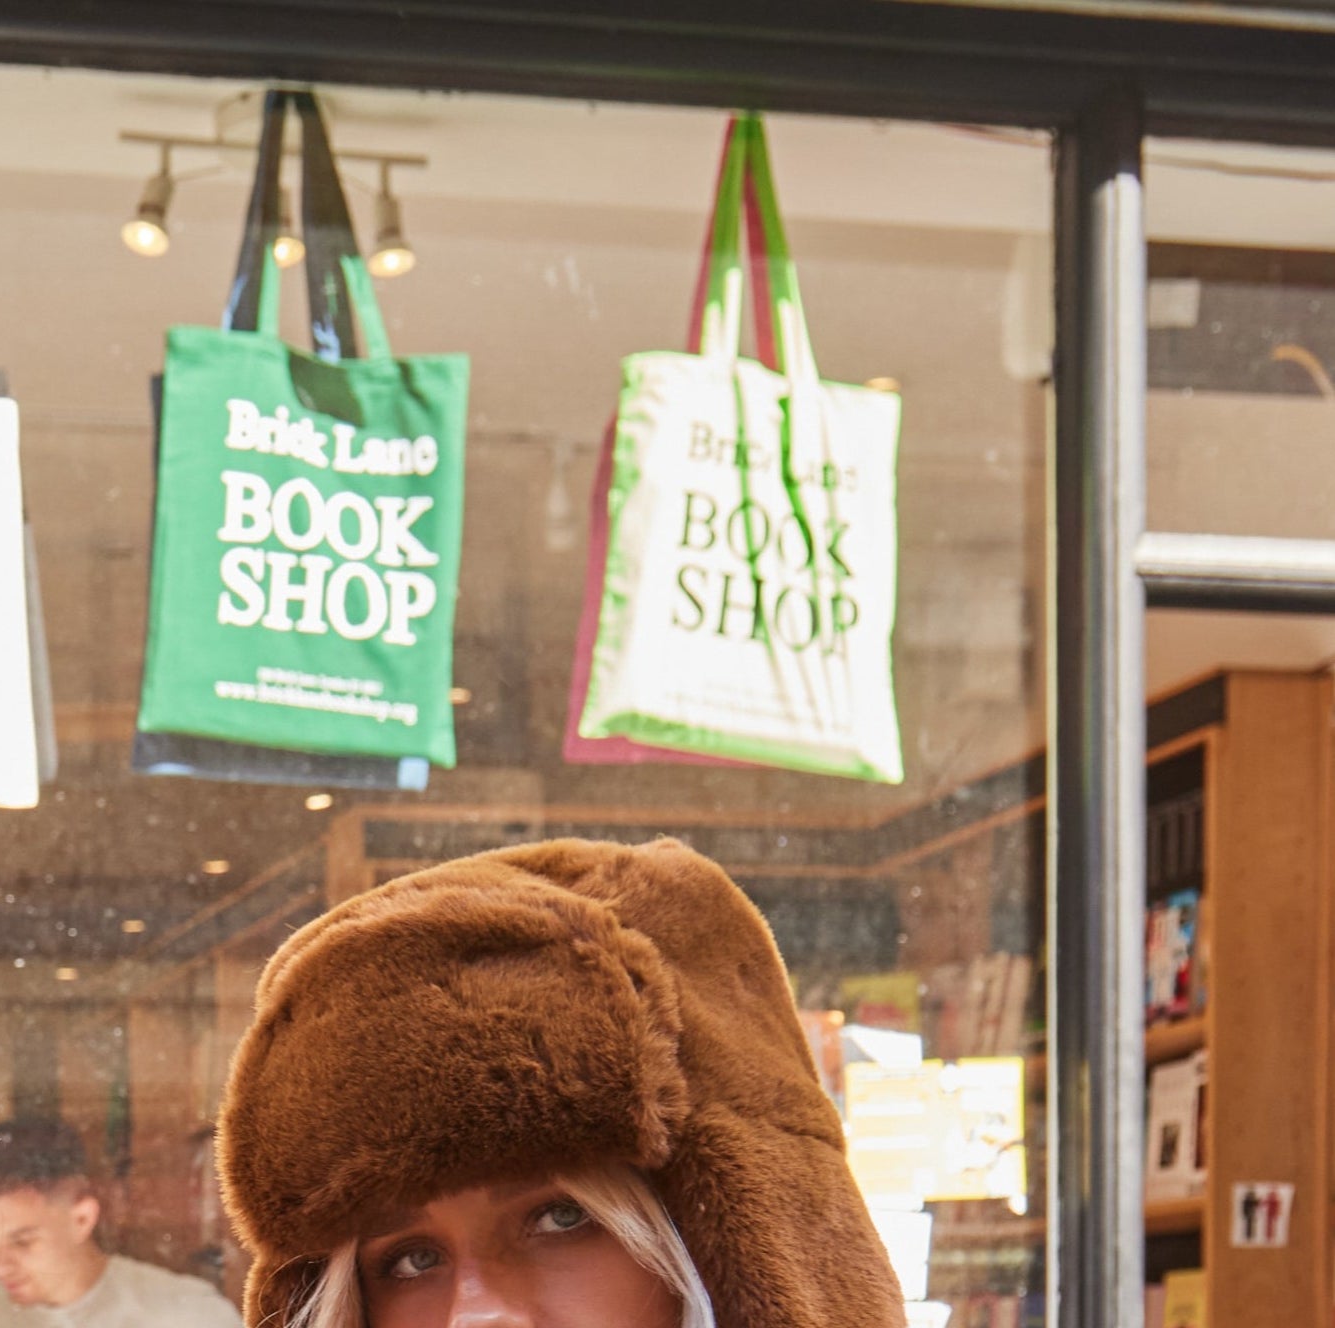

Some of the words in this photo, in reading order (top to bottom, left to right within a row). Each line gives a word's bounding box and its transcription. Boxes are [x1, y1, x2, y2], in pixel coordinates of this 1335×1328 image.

[225, 398, 329, 469] Brick
[332, 424, 438, 476] Lane
[218, 470, 439, 567] BOOK
[217, 547, 436, 646] SHOP
[672, 564, 858, 656] SHOP
